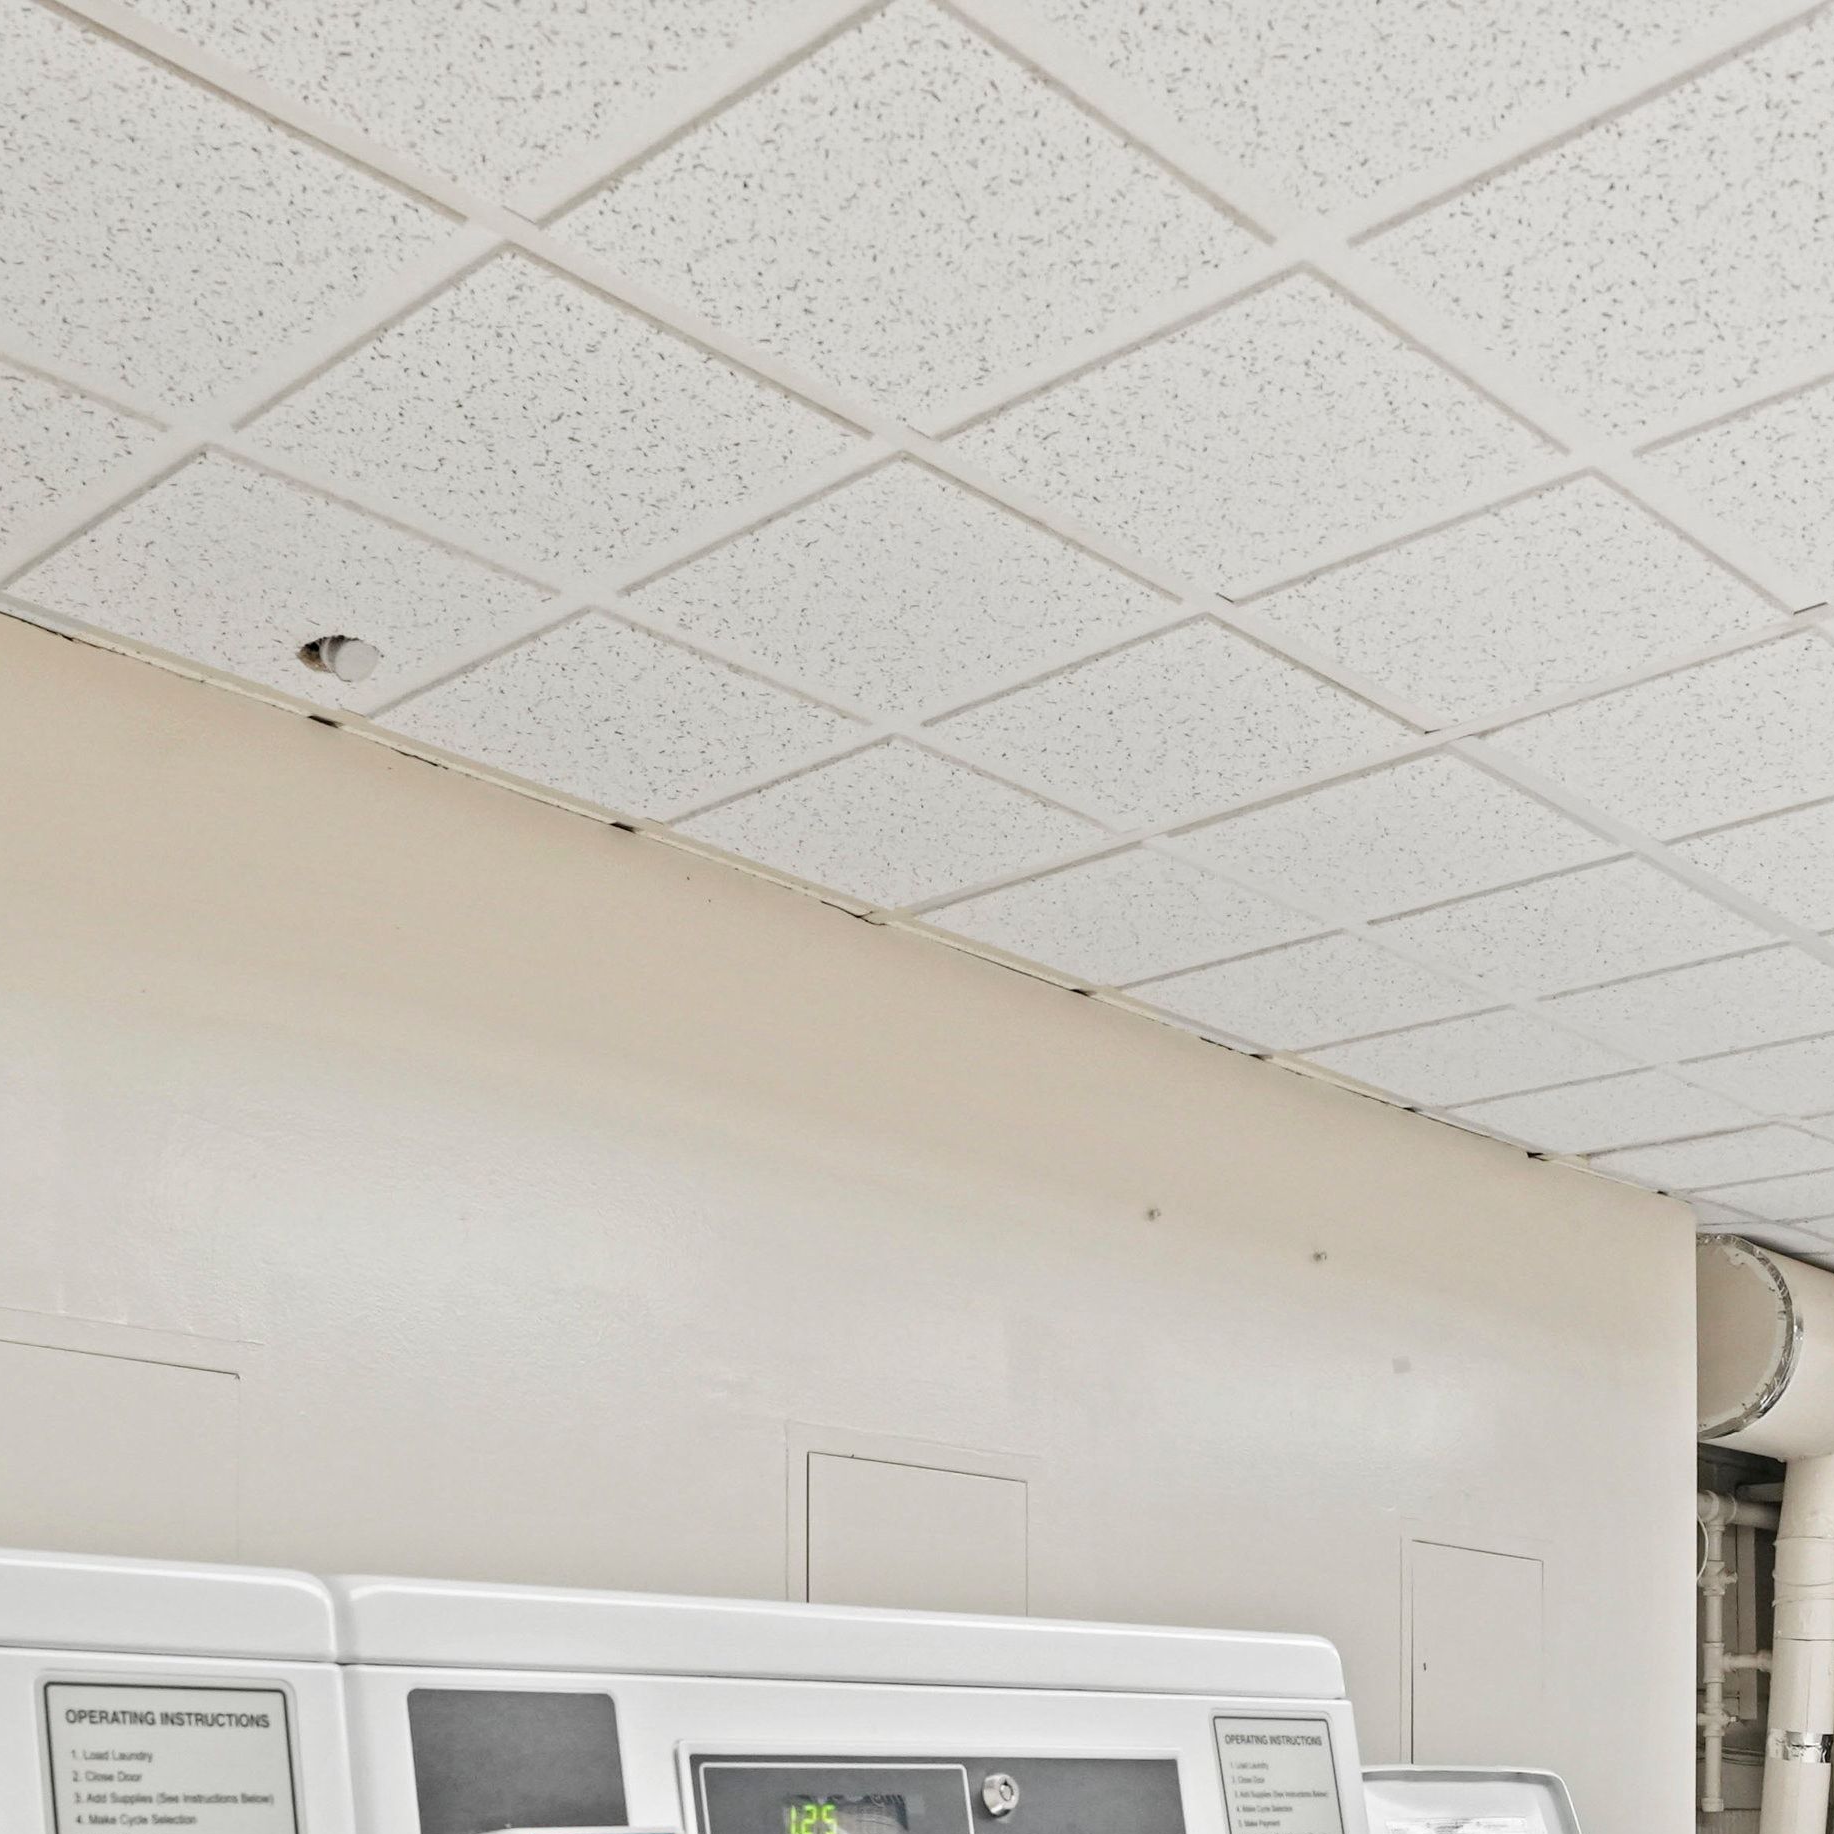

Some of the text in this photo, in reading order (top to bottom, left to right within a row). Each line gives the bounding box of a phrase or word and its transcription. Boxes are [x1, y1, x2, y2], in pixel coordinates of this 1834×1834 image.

[66, 1709, 270, 1728] OPERATING INSTRUCTIONS
[1225, 1734, 1322, 1746] OPERATING INSTRUCTIONS
